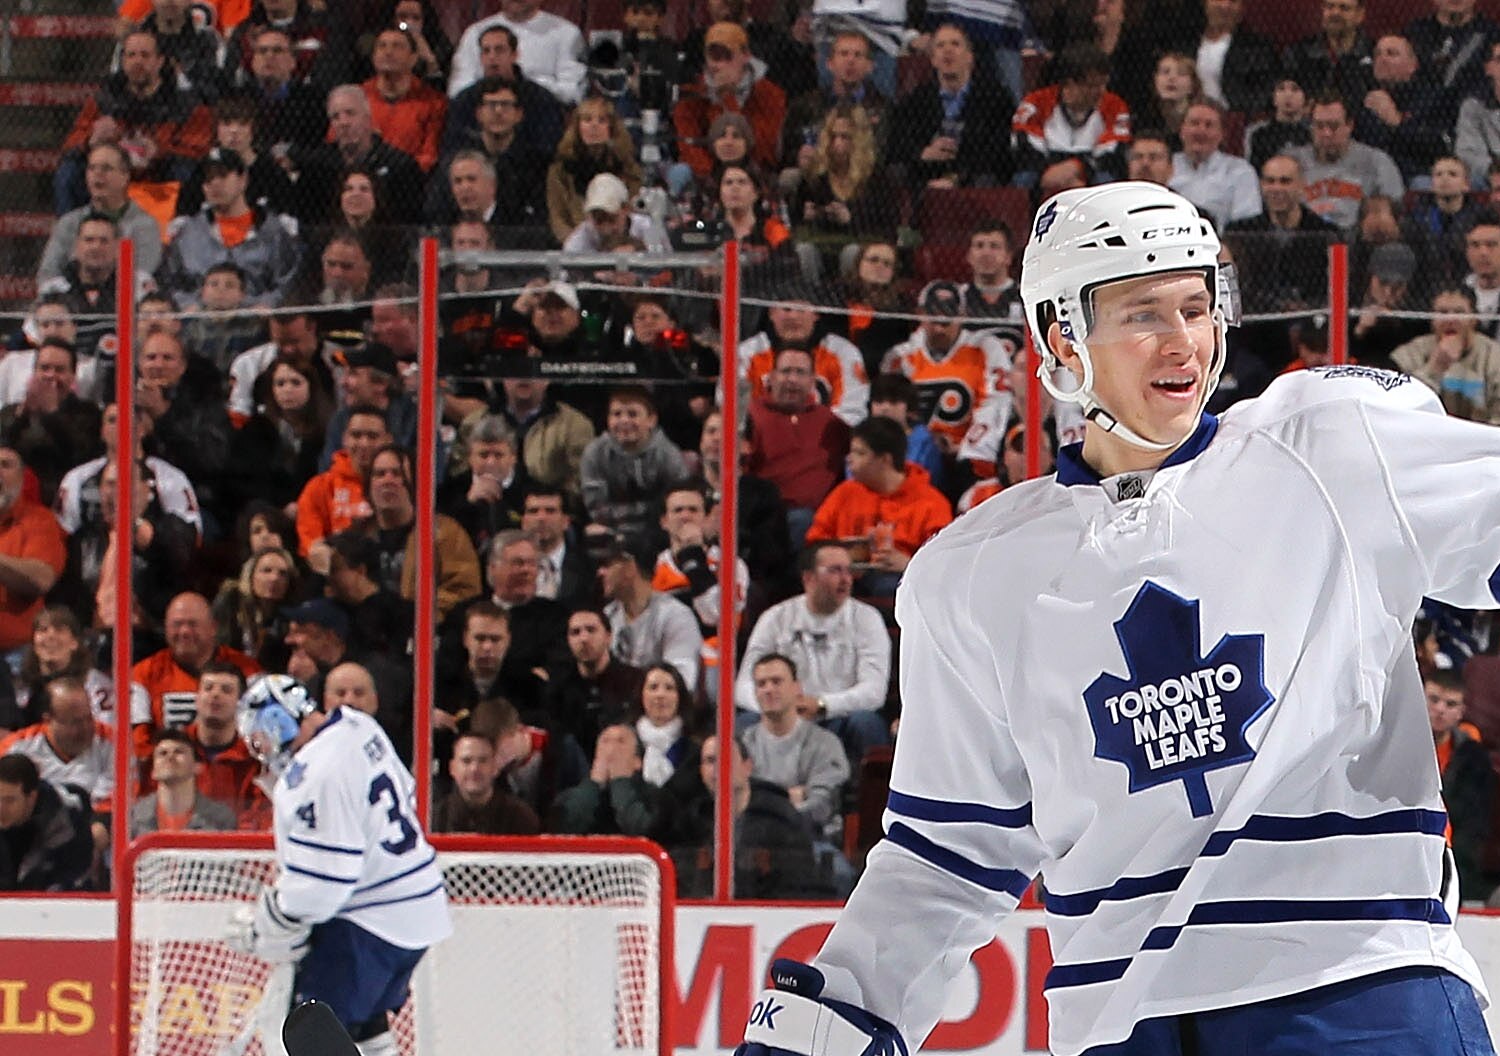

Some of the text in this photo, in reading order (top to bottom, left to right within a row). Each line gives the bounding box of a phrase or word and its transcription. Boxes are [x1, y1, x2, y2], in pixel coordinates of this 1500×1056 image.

[1104, 663, 1243, 725] TORONTO
[1132, 695, 1227, 746] MAPLE
[1143, 724, 1228, 771] LEAFS
[777, 973, 798, 988] Leafs
